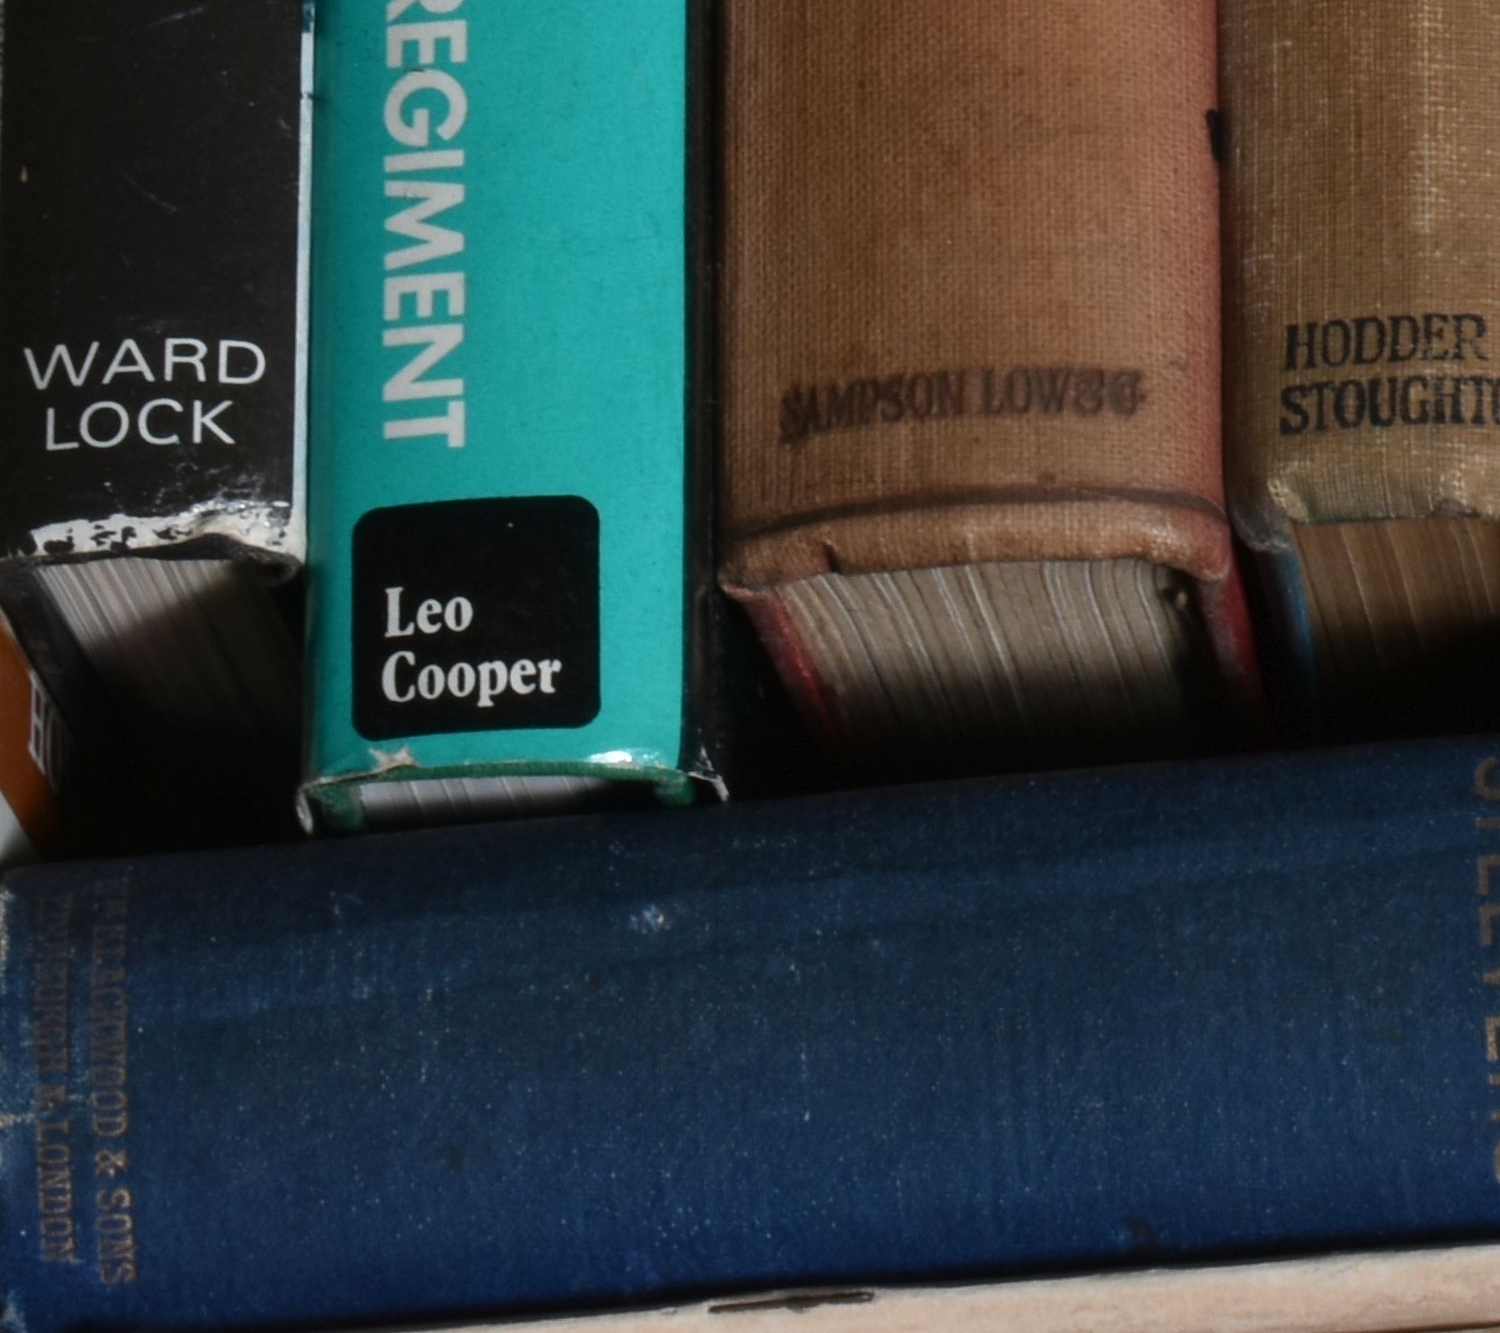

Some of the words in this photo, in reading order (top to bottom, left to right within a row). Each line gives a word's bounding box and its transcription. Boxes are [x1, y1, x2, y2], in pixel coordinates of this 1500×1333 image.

[23, 337, 267, 392] WARD
[1282, 313, 1488, 373] HODDER
[45, 398, 236, 452] LOCK
[383, 585, 474, 639] Leo
[380, 650, 564, 708] Cooper
[36, 1116, 78, 1265] LONDON
[96, 1187, 138, 1285] SONS
